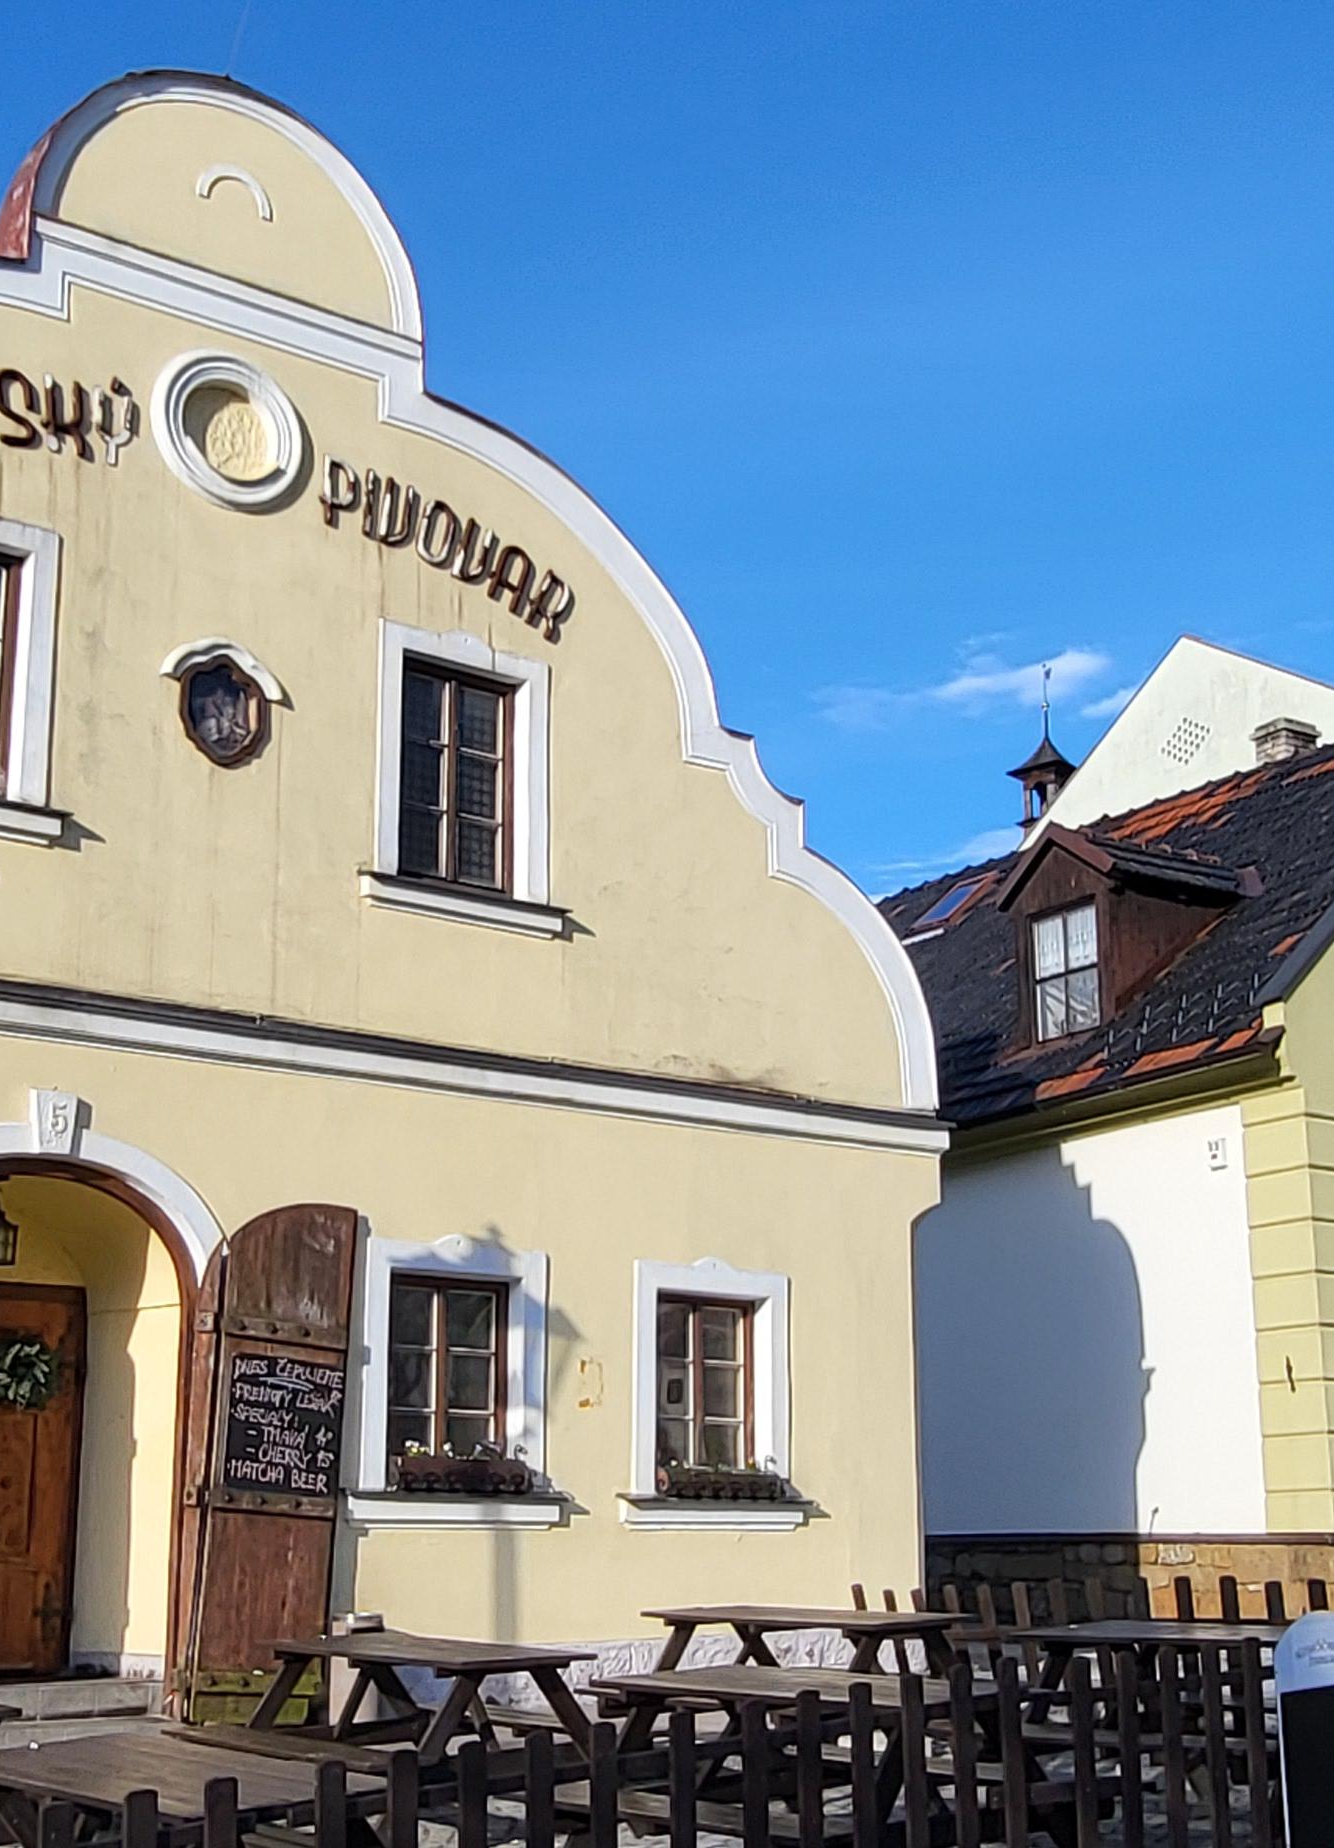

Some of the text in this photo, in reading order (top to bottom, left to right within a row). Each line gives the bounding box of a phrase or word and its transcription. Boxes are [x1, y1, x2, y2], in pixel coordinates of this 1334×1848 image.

[319, 453, 575, 643] PIVOVAR
[51, 1102, 69, 1135] 5
[258, 1444, 313, 1469] CHERRY
[291, 1469, 328, 1494] BEER
